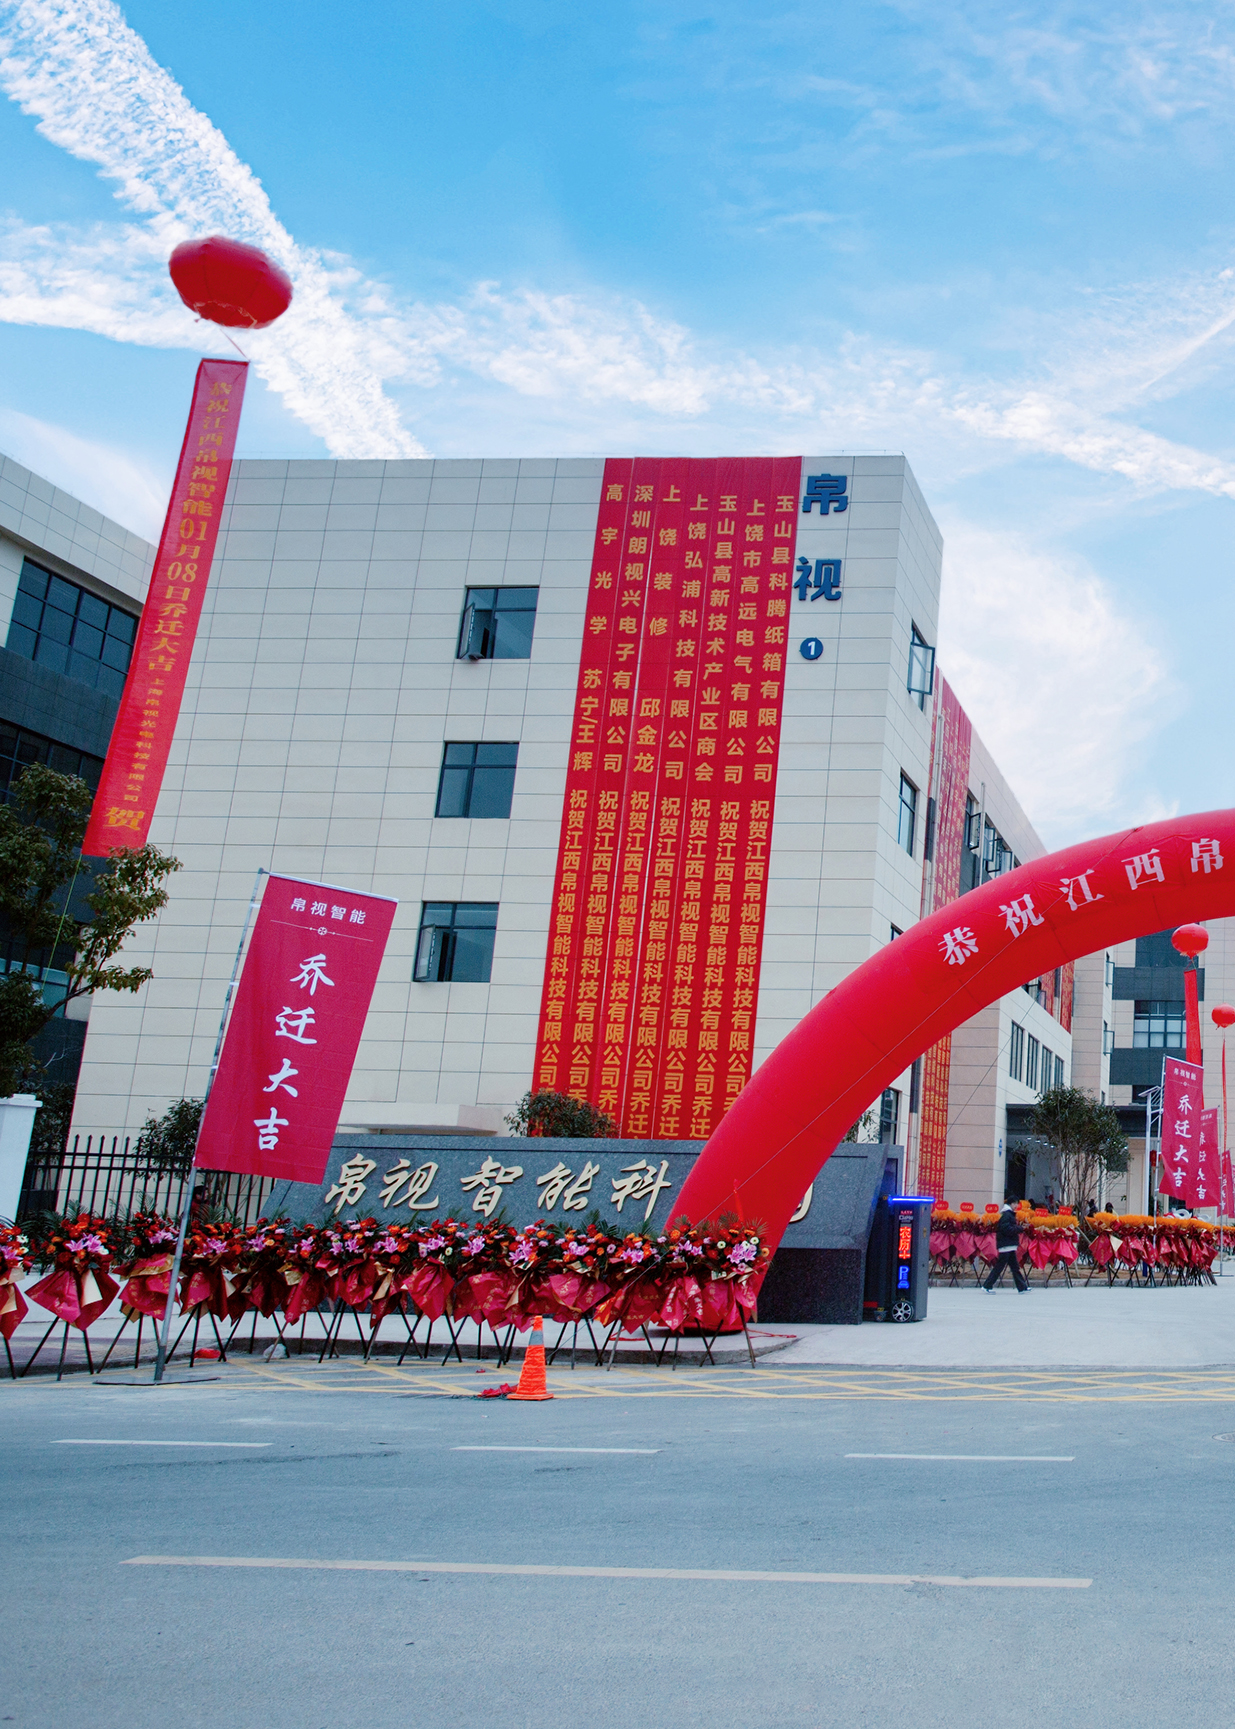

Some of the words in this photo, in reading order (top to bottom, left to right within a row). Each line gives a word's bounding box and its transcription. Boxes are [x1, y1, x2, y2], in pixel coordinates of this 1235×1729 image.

[793, 473, 849, 602] 帛视
[290, 897, 367, 925] 帛视智能
[253, 953, 335, 1150] 乔迁大吉
[1173, 1094, 1193, 1188] 乔迁大吉
